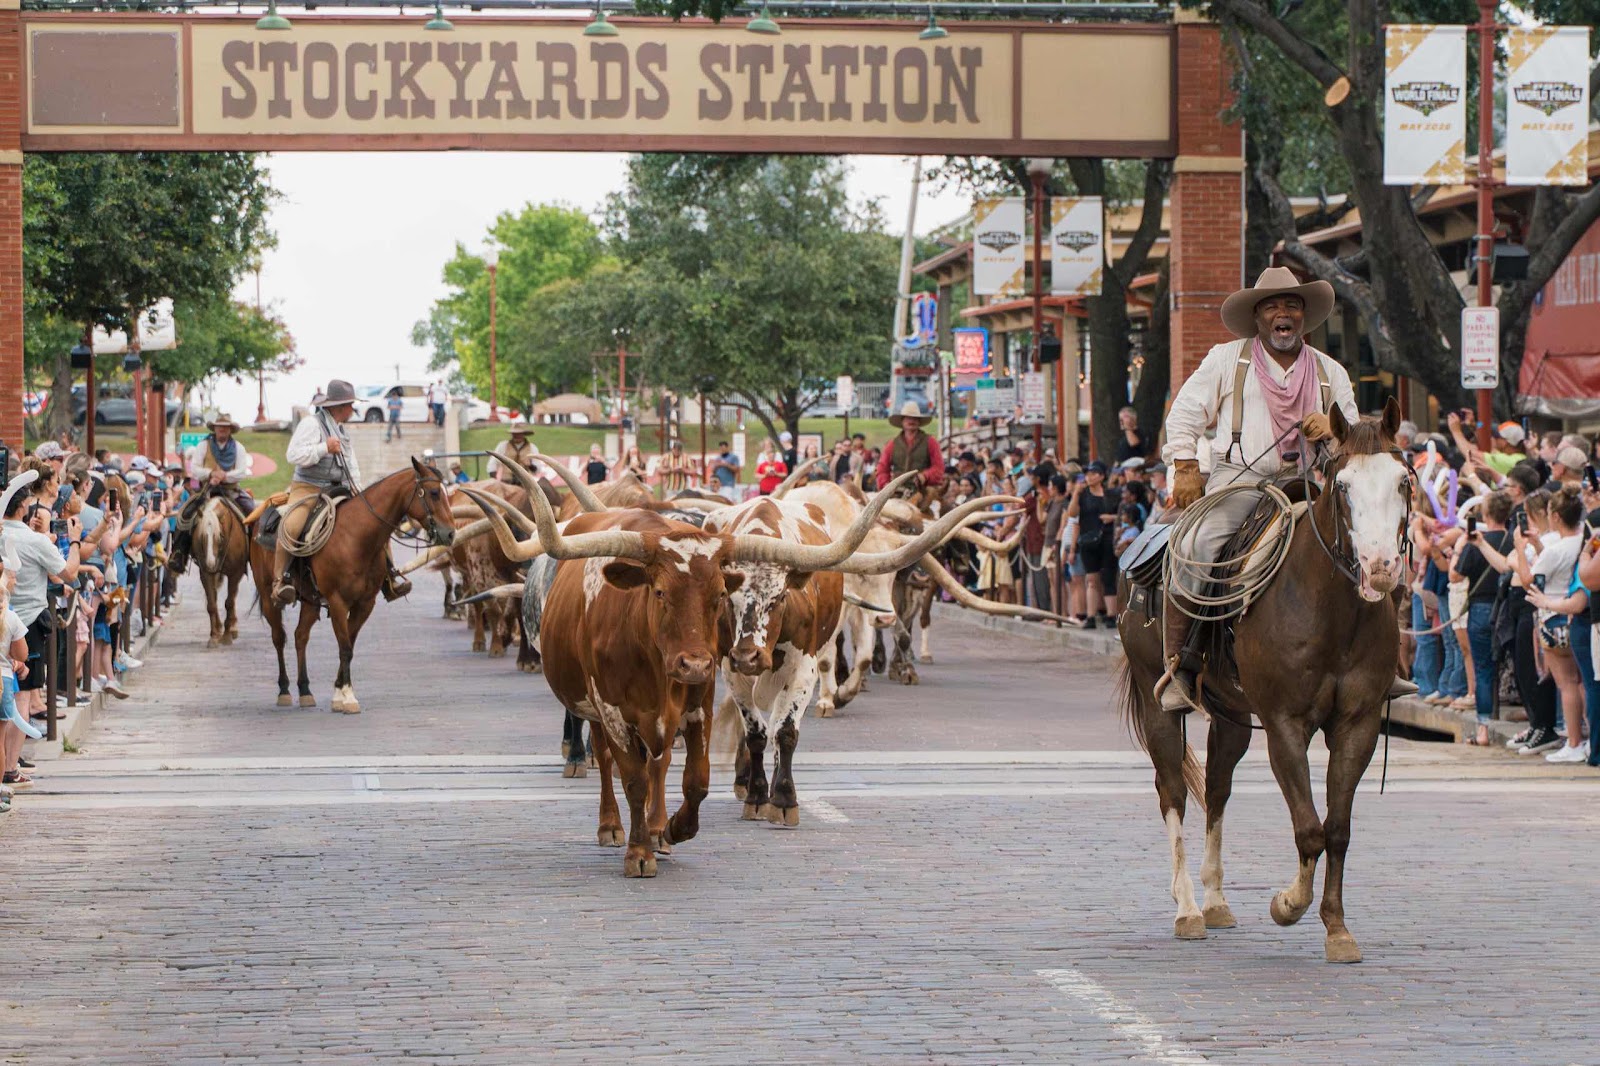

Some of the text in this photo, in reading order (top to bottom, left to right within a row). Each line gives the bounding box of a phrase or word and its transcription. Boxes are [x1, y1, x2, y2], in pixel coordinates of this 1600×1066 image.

[222, 40, 983, 124] STOCKYARDS STATION
[1393, 89, 1458, 102] WORLD FINALS
[1515, 89, 1581, 102] WORLD FINALS
[1399, 123, 1421, 131] MAY
[1521, 123, 1545, 131] MAY
[1475, 314, 1486, 322] NO
[1467, 324, 1495, 332] PARKING
